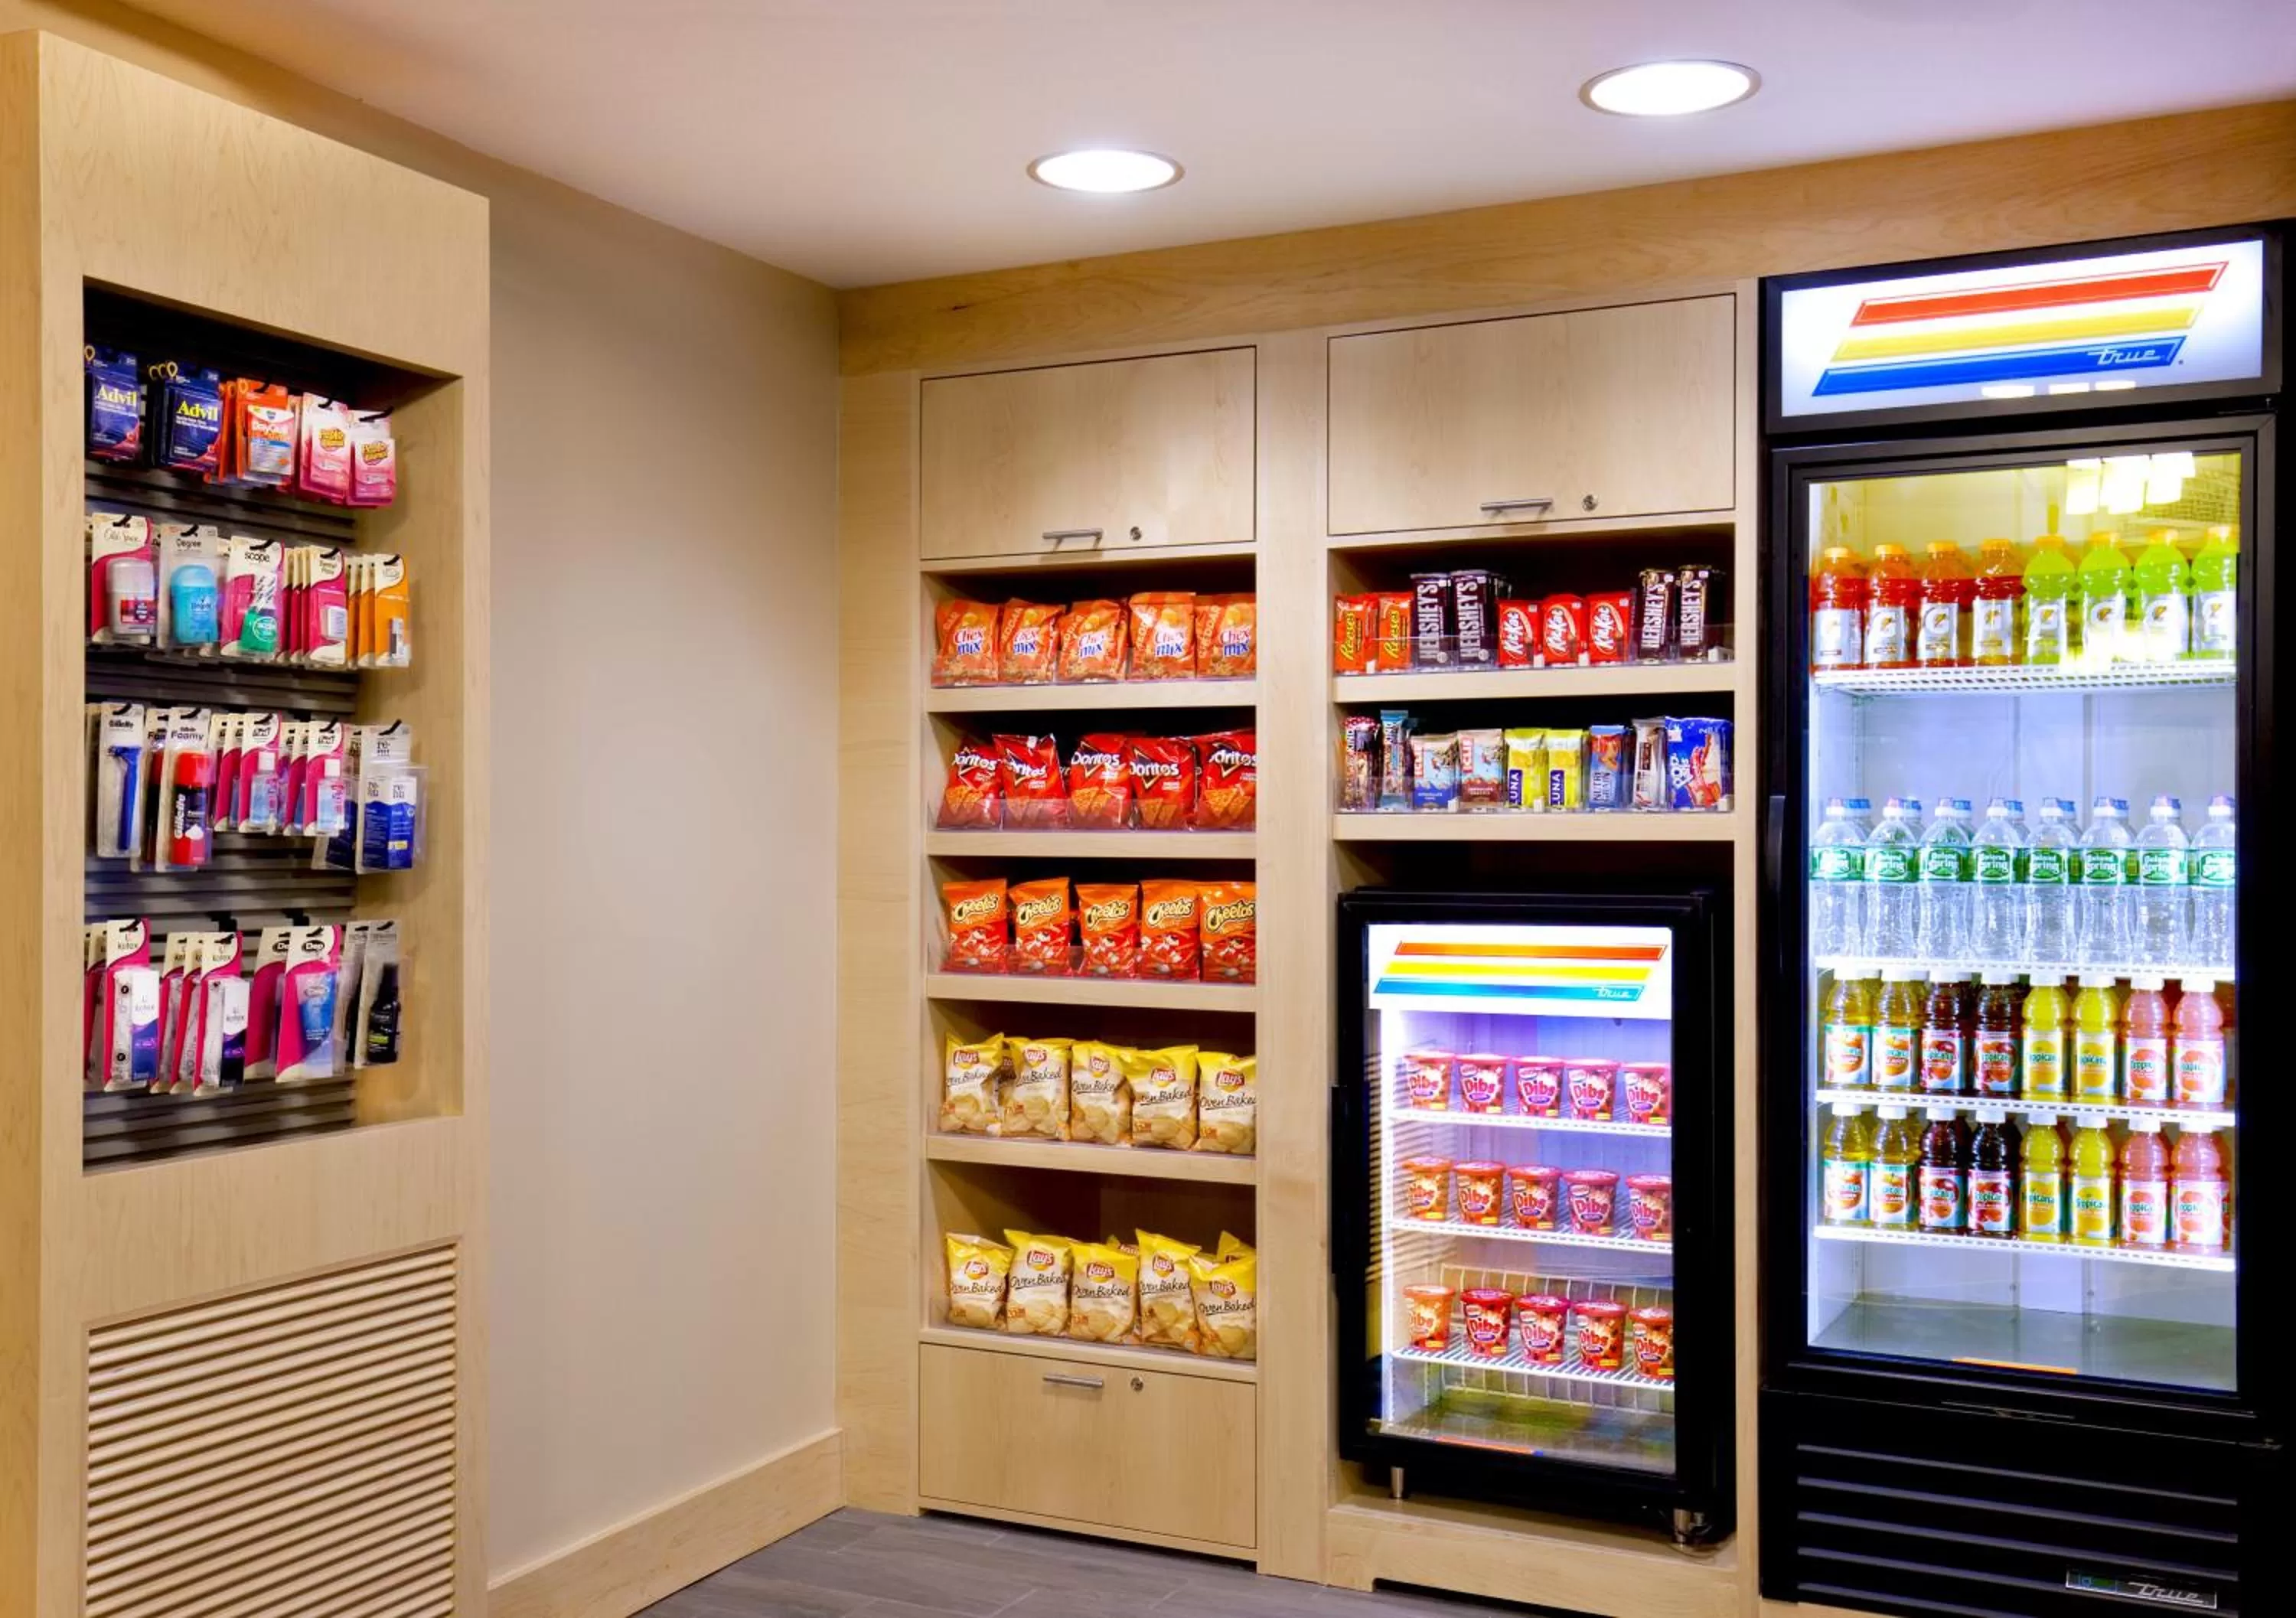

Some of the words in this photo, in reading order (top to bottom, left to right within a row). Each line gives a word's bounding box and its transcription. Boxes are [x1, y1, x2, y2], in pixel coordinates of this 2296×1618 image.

[97, 383, 138, 408] Advil
[177, 400, 218, 421] Advil
[175, 538, 201, 550] Degree
[244, 551, 270, 563] scope
[1417, 583, 1440, 659] HERSHEY'S
[1456, 581, 1481, 658] HERSHEY'S
[1642, 582, 1665, 649] HERSHEY'S
[1681, 579, 1701, 646] HERSHEY'S
[108, 719, 134, 728] Gillette
[148, 732, 167, 741] Foa
[171, 732, 204, 741] Foamy
[1008, 757, 1047, 777] oritos
[1071, 751, 1120, 767] Doritos
[954, 894, 1000, 923] Cheetos
[1016, 895, 1062, 925] Cheetos
[1085, 900, 1130, 931] Cheetos
[1148, 897, 1194, 925] Cheetos
[1206, 899, 1256, 931] Cheetos
[306, 942, 325, 951] Dep
[2130, 1060, 2154, 1070] Tropic
[1092, 1079, 1115, 1092] Bake
[1463, 1076, 1495, 1093] Dibs
[1524, 1080, 1556, 1095] Dibs
[1574, 1082, 1606, 1098] Dibs
[1200, 1094, 1225, 1108] Oven
[1628, 1085, 1658, 1102] Dibs
[1459, 1188, 1489, 1204] Dibs
[1515, 1191, 1547, 1210] Dibs
[2076, 1197, 2106, 1209] Tropica
[1575, 1197, 1608, 1214] Dibs
[1010, 1275, 1034, 1287] Oven
[1037, 1270, 1066, 1284] Baked
[1097, 1284, 1130, 1297] Baked
[1224, 1298, 1256, 1311] Baked
[1469, 1316, 1502, 1332] Dibs
[1525, 1323, 1555, 1341] Dibs
